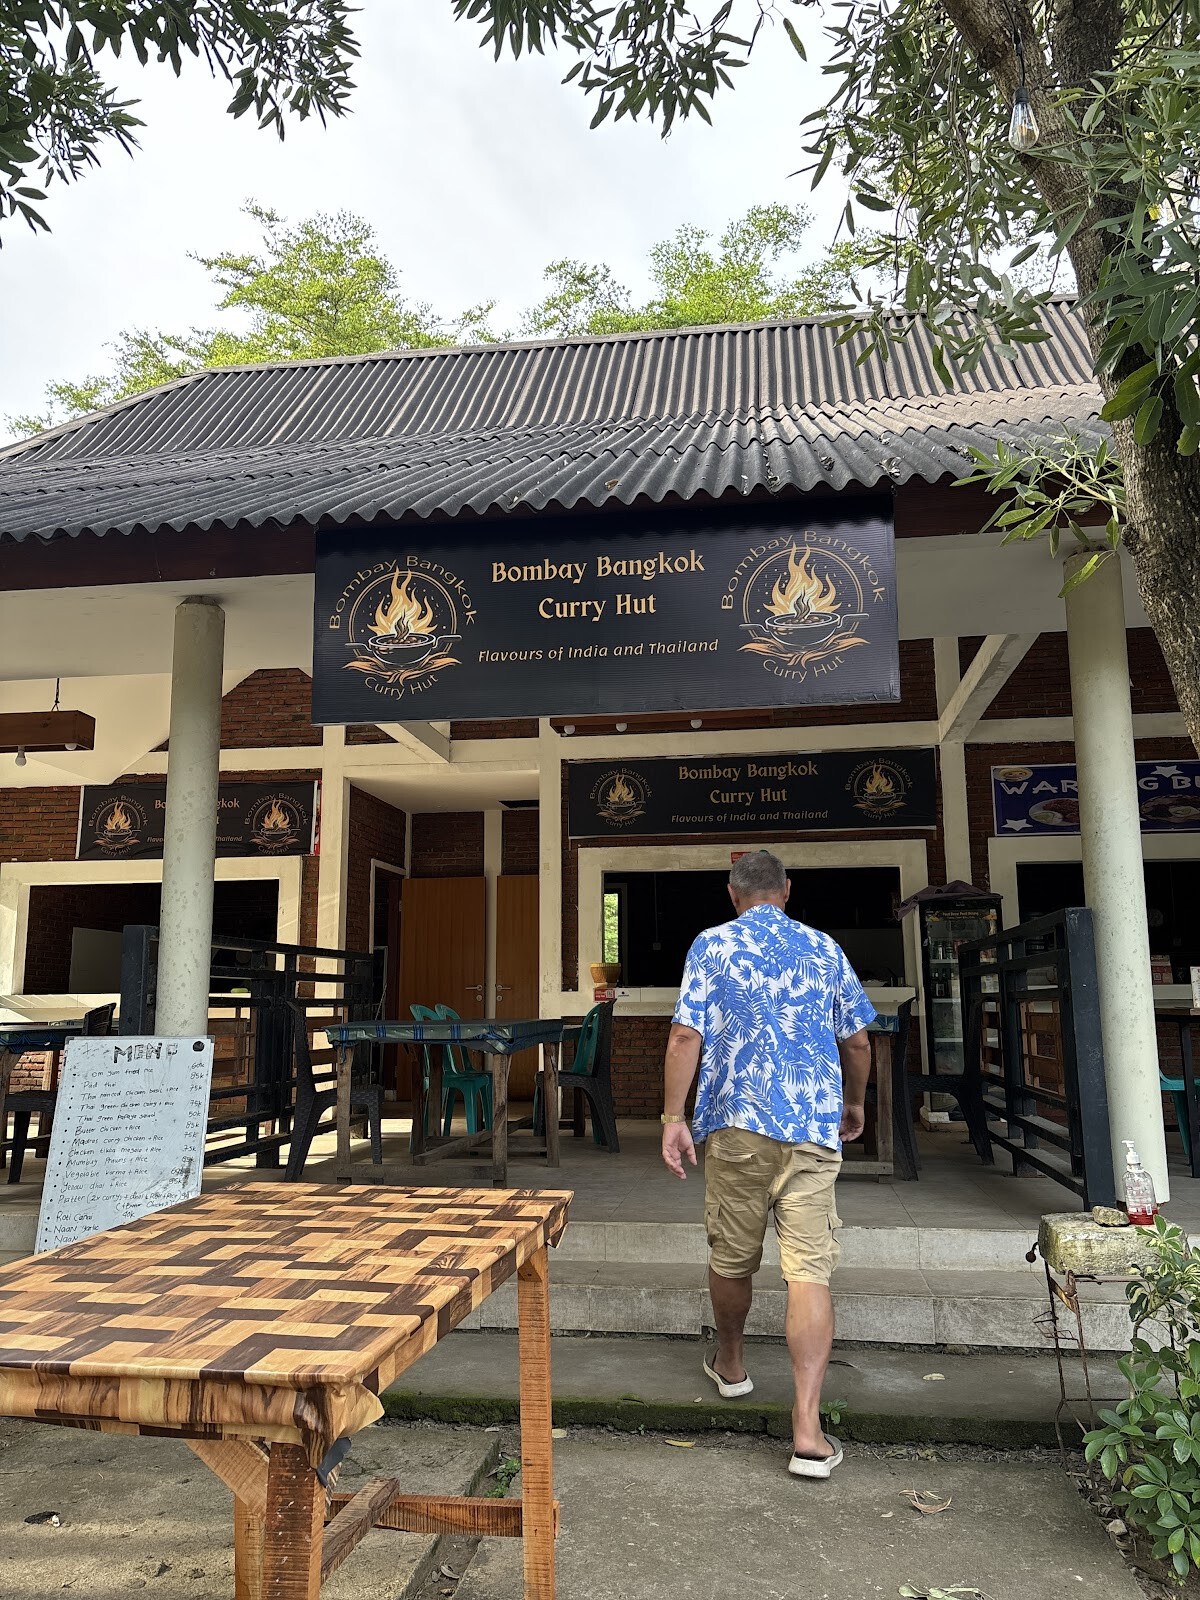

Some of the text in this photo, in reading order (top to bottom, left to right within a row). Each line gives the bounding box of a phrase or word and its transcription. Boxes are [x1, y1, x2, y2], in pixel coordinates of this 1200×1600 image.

[491, 549, 706, 584] Bombay Bangkok
[722, 530, 886, 610] Bombay Bangkok
[329, 556, 477, 629] Bombay Bangkok
[538, 592, 657, 622] Curry Hut
[478, 638, 720, 662] Flavours of India and Thailand
[762, 655, 846, 684] Curry Hut
[365, 674, 439, 700] Curry Hut
[678, 760, 819, 782] Bombay Bangkok
[710, 788, 788, 806] Curry Hut
[672, 810, 828, 824] Flavours of India and Thailand
